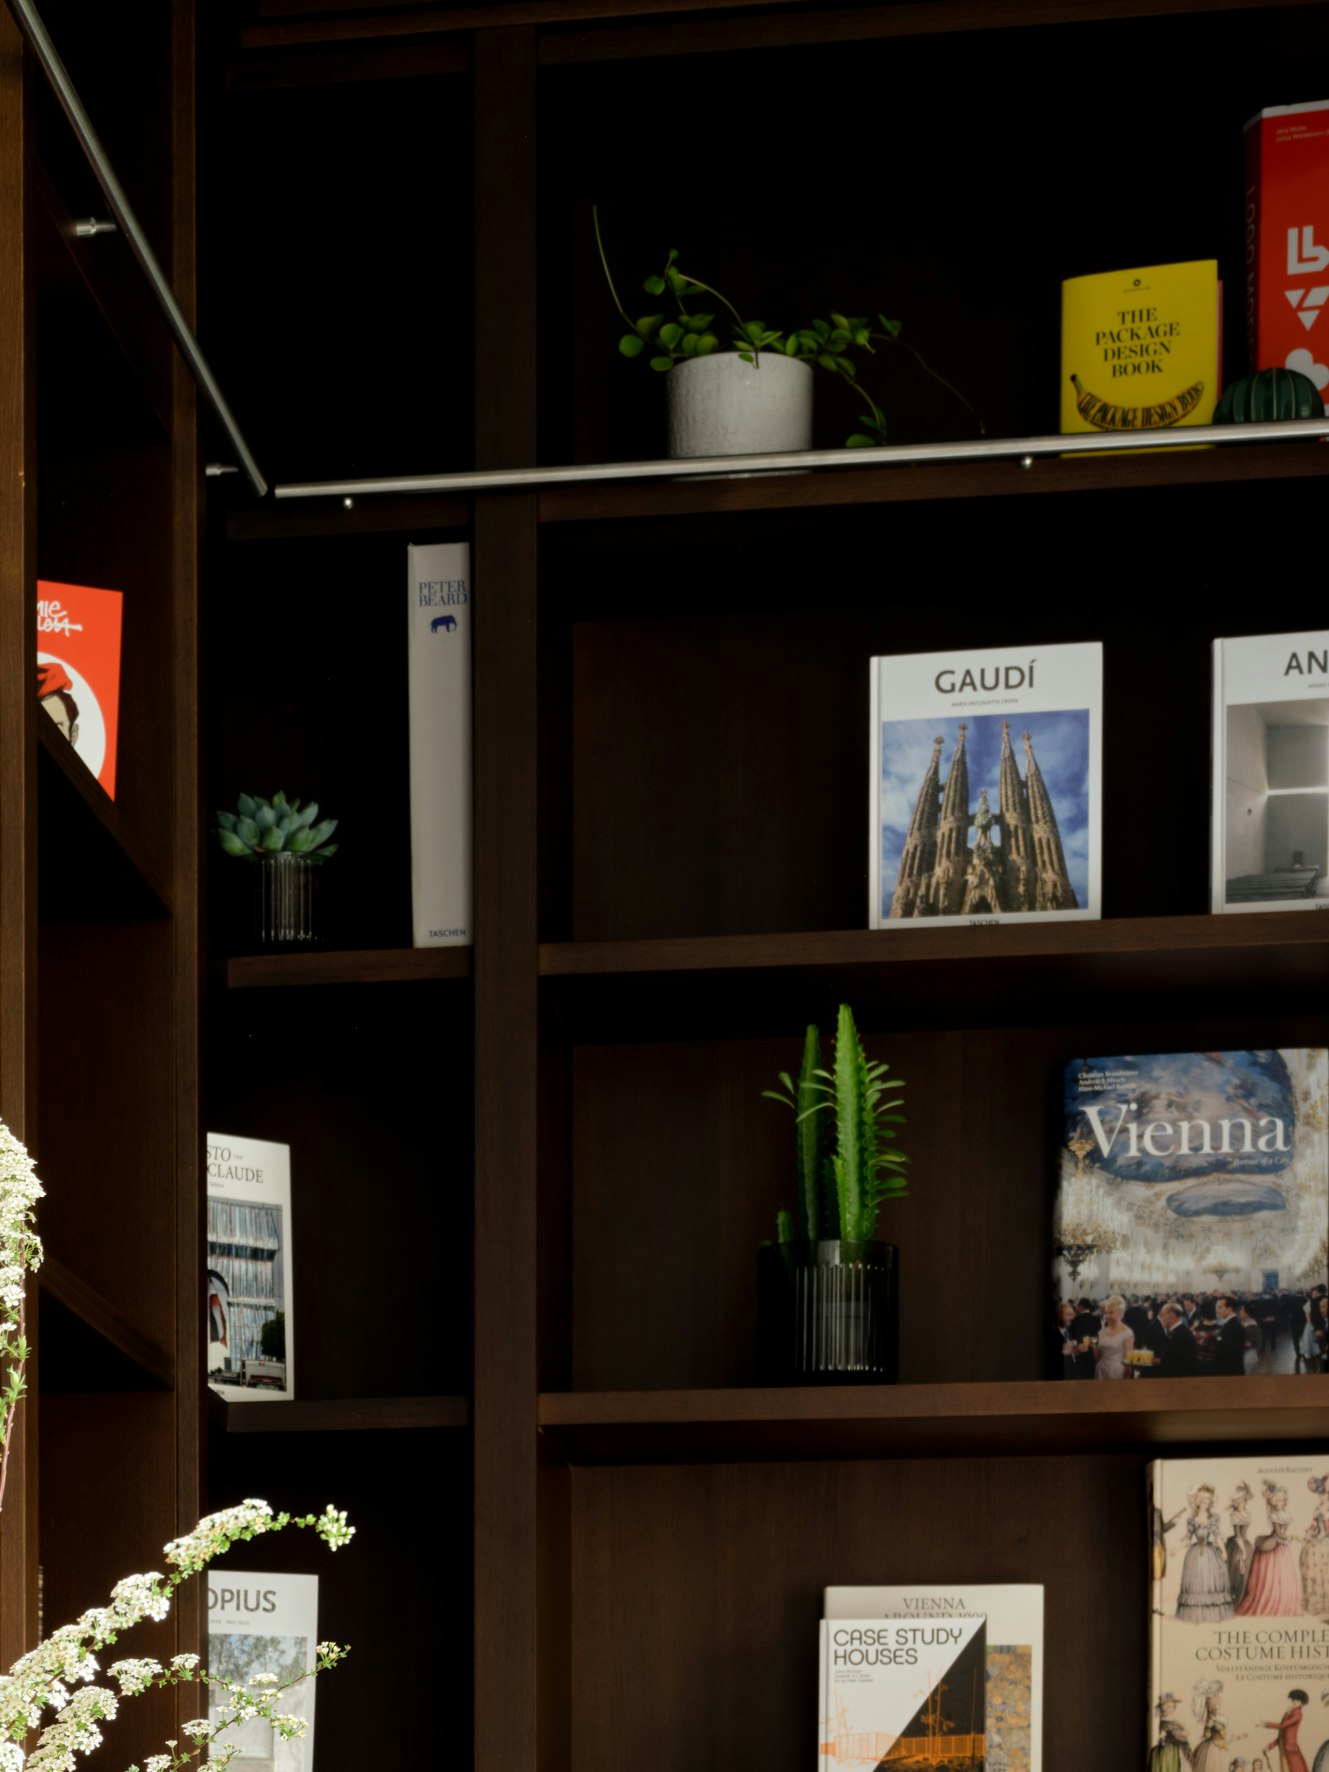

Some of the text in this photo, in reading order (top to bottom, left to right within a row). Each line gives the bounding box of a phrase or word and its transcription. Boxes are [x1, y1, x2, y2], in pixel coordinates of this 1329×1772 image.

[1117, 307, 1157, 325] THE
[1095, 322, 1180, 346] PACKAGE
[1104, 341, 1171, 362] DESIGN
[1112, 359, 1164, 378] BOOK
[419, 580, 466, 592] PETER
[419, 593, 468, 607] BEARD
[934, 658, 1037, 694] GAUDÍ
[429, 929, 466, 938] TASCHEN
[1079, 1102, 1291, 1158] Vienna
[902, 1598, 966, 1610] VIENNA
[834, 1628, 962, 1646] CASE STUDY
[1213, 1629, 1329, 1644] THE COMPLE
[834, 1648, 918, 1666] HOUSES
[1196, 1646, 1286, 1661] COSTUME
